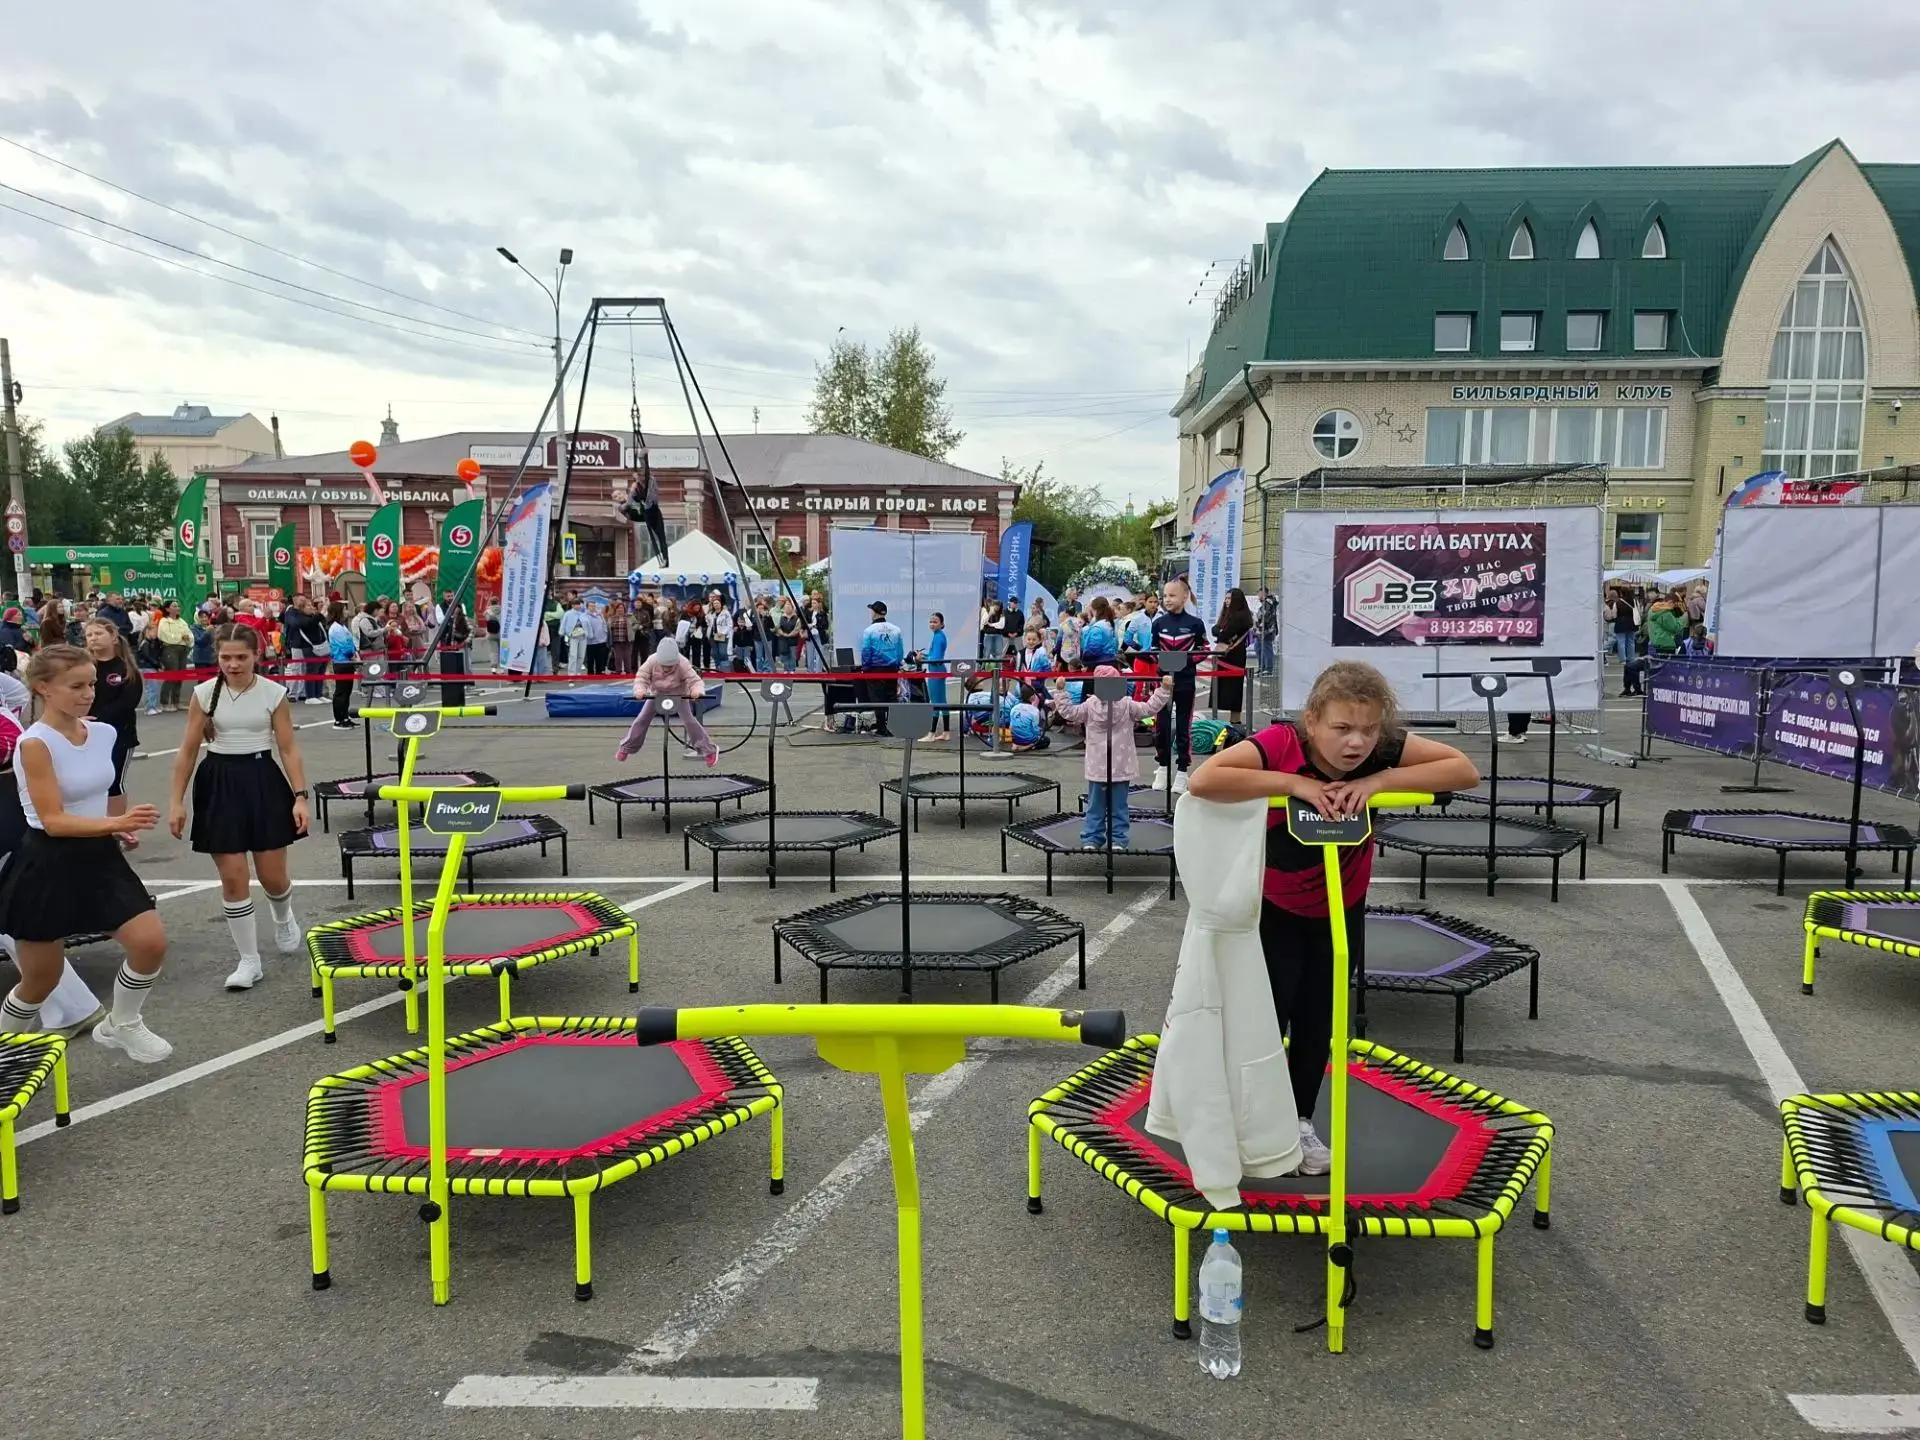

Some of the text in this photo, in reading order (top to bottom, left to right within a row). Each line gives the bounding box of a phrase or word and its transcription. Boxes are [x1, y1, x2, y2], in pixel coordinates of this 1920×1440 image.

[1452, 382, 1673, 401] БИЛЬЯРДНЫЙ КЛУБ
[565, 439, 610, 451] ТАРЫЙ
[564, 453, 605, 466] ОРОД
[248, 489, 307, 500] ОДЕЖДА
[321, 490, 368, 501] ОБУВЬ
[383, 491, 450, 502] РЫБАЛКА
[745, 496, 987, 513] КАФЕ «СТАРЫЙ ГОРОД» КАФЕ
[1346, 533, 1534, 552] ФИТНЕС НА БАТУТАХ
[1463, 560, 1502, 574] У НАС
[123, 587, 177, 598] БАРНАУЛ
[1359, 582, 1436, 604] JBS
[1446, 590, 1538, 613] ТВОЯ ПОДРУГА
[1430, 620, 1534, 634] 8 913 256 77 92
[1829, 720, 1880, 742] НАЧИНАТСЯ
[1862, 749, 1884, 766] ОБОЙ
